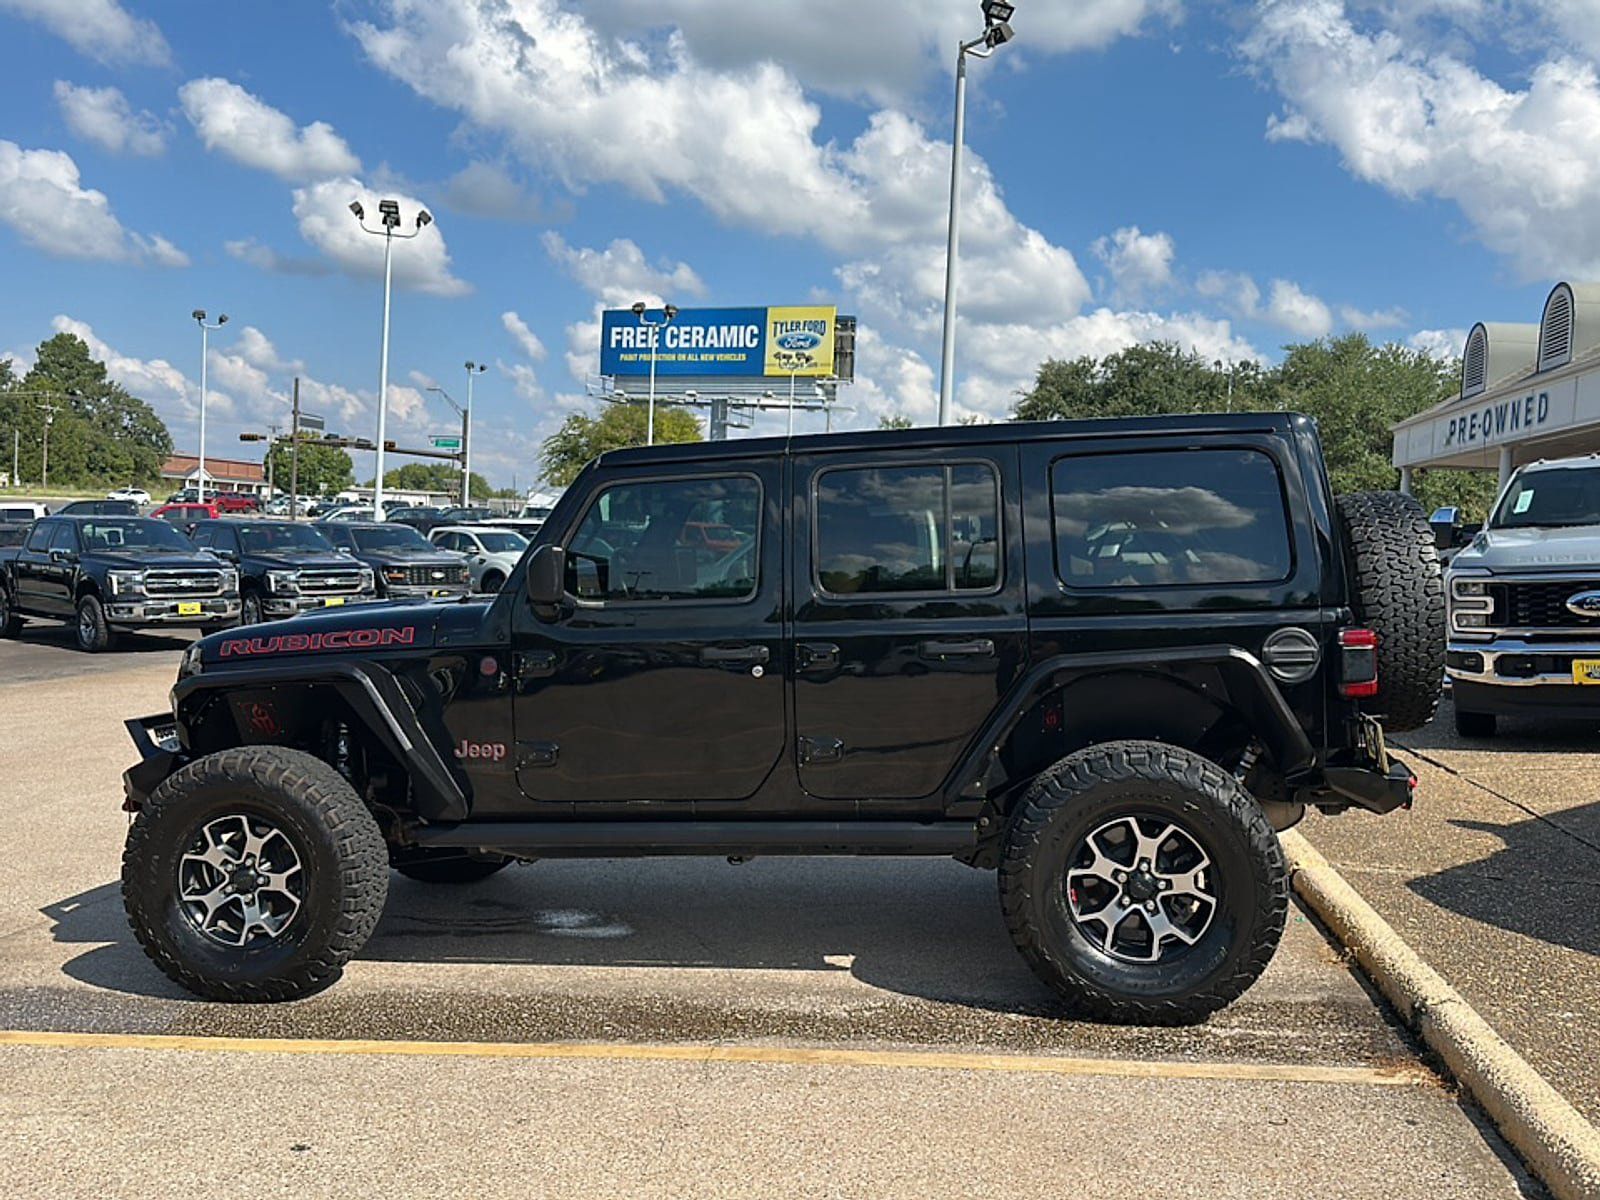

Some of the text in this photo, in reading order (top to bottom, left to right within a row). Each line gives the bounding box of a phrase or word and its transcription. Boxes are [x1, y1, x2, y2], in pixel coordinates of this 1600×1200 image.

[610, 325, 759, 349] FREE CERAMIC
[773, 320, 826, 338] TYLER FORD
[1449, 393, 1548, 443] PRE-OWNED
[220, 627, 415, 656] RUBICON
[454, 739, 506, 761] Jeep
